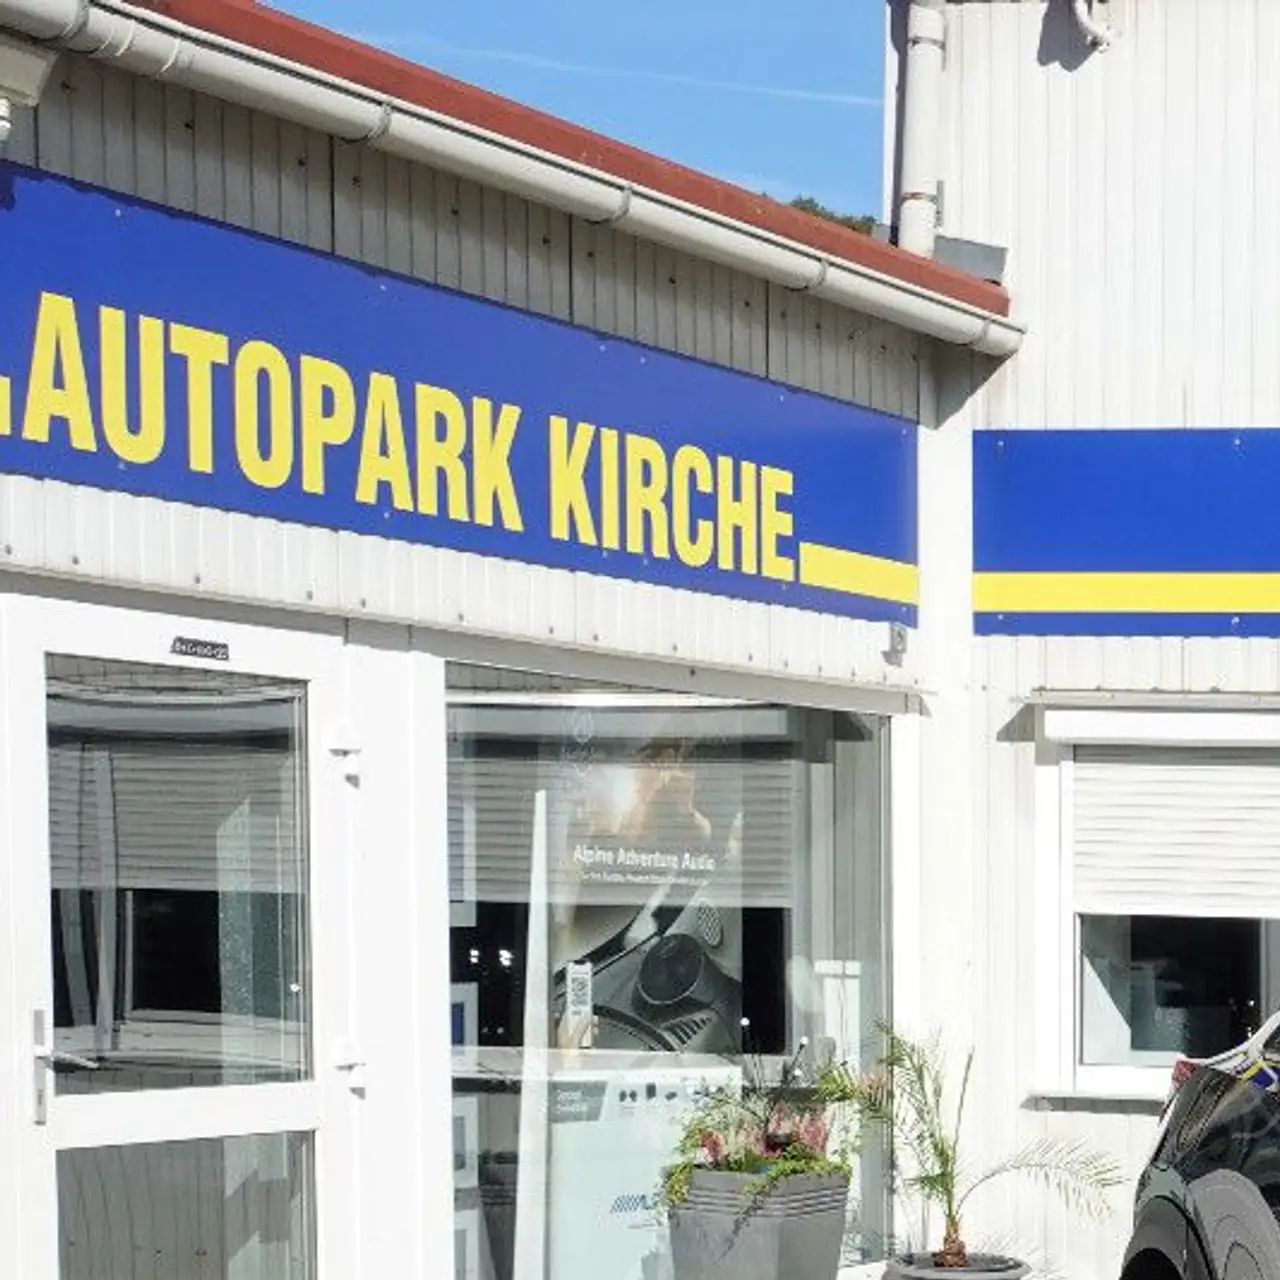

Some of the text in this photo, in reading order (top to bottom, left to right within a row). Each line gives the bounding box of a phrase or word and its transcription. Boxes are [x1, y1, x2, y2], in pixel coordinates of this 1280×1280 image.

[23, 293, 795, 580] AUTOPARK KIRCHE
[573, 845, 717, 872] Alpine Adventure Audio
